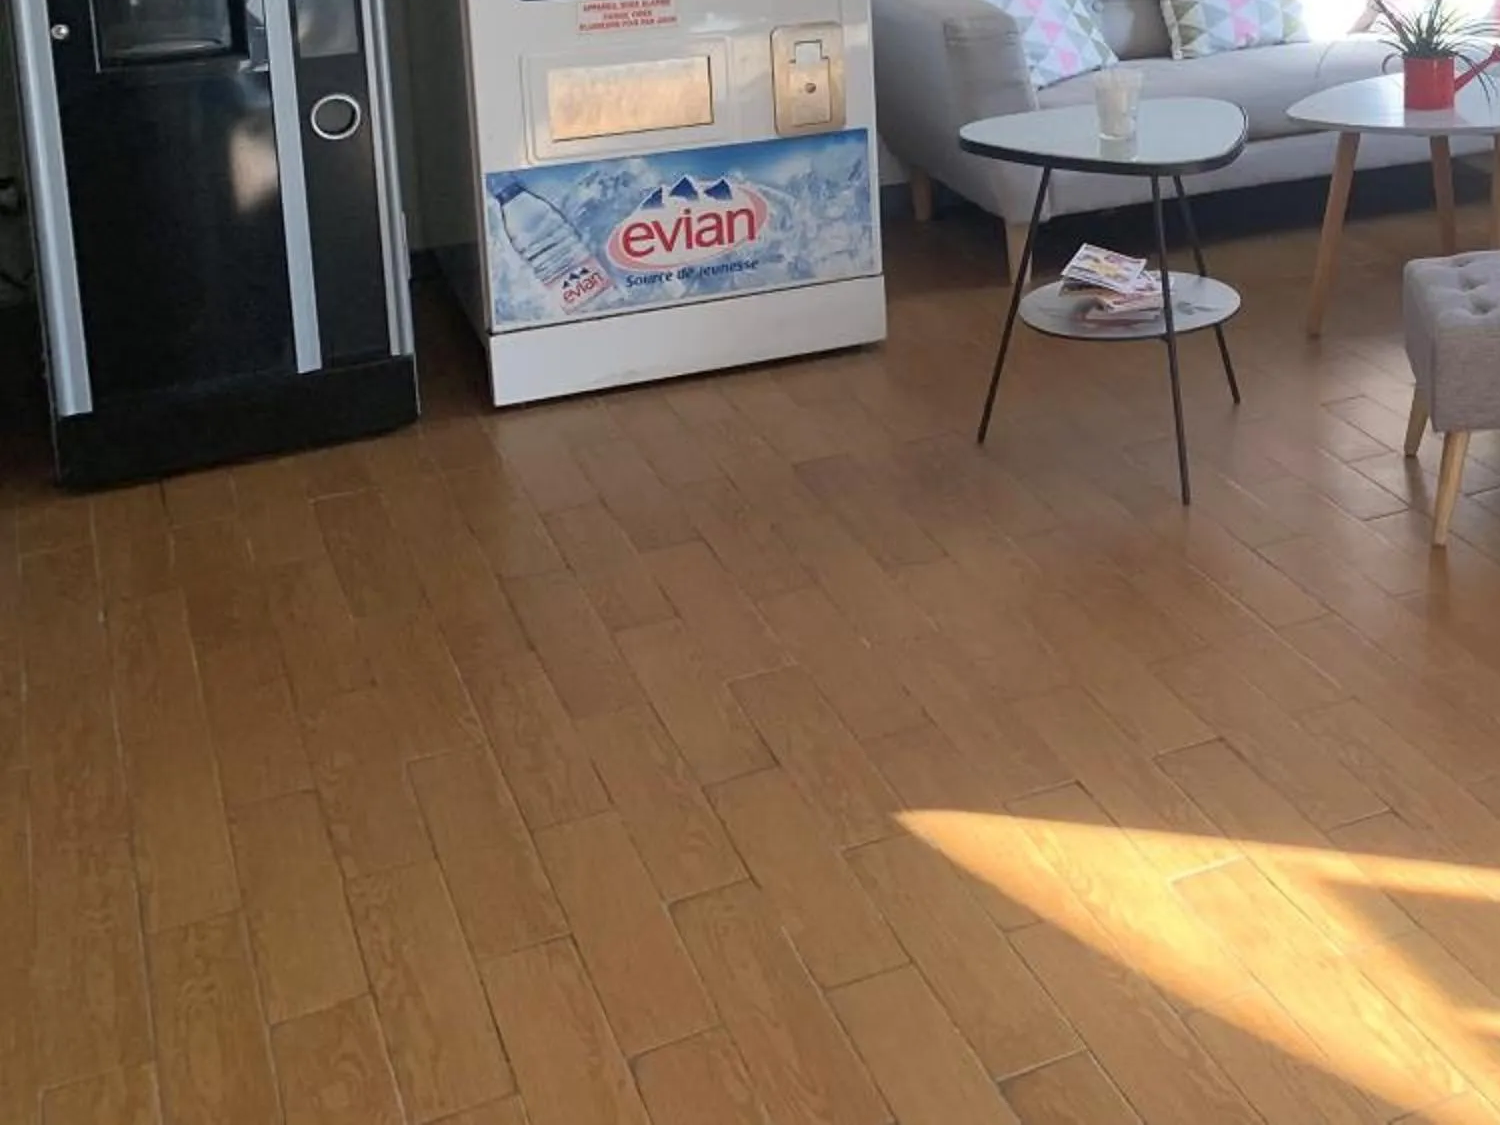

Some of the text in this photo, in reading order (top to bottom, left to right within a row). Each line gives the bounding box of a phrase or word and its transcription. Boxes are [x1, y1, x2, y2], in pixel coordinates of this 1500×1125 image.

[621, 208, 757, 259] evian
[562, 272, 603, 304] evian
[625, 270, 674, 288] Source
[677, 265, 695, 280] de
